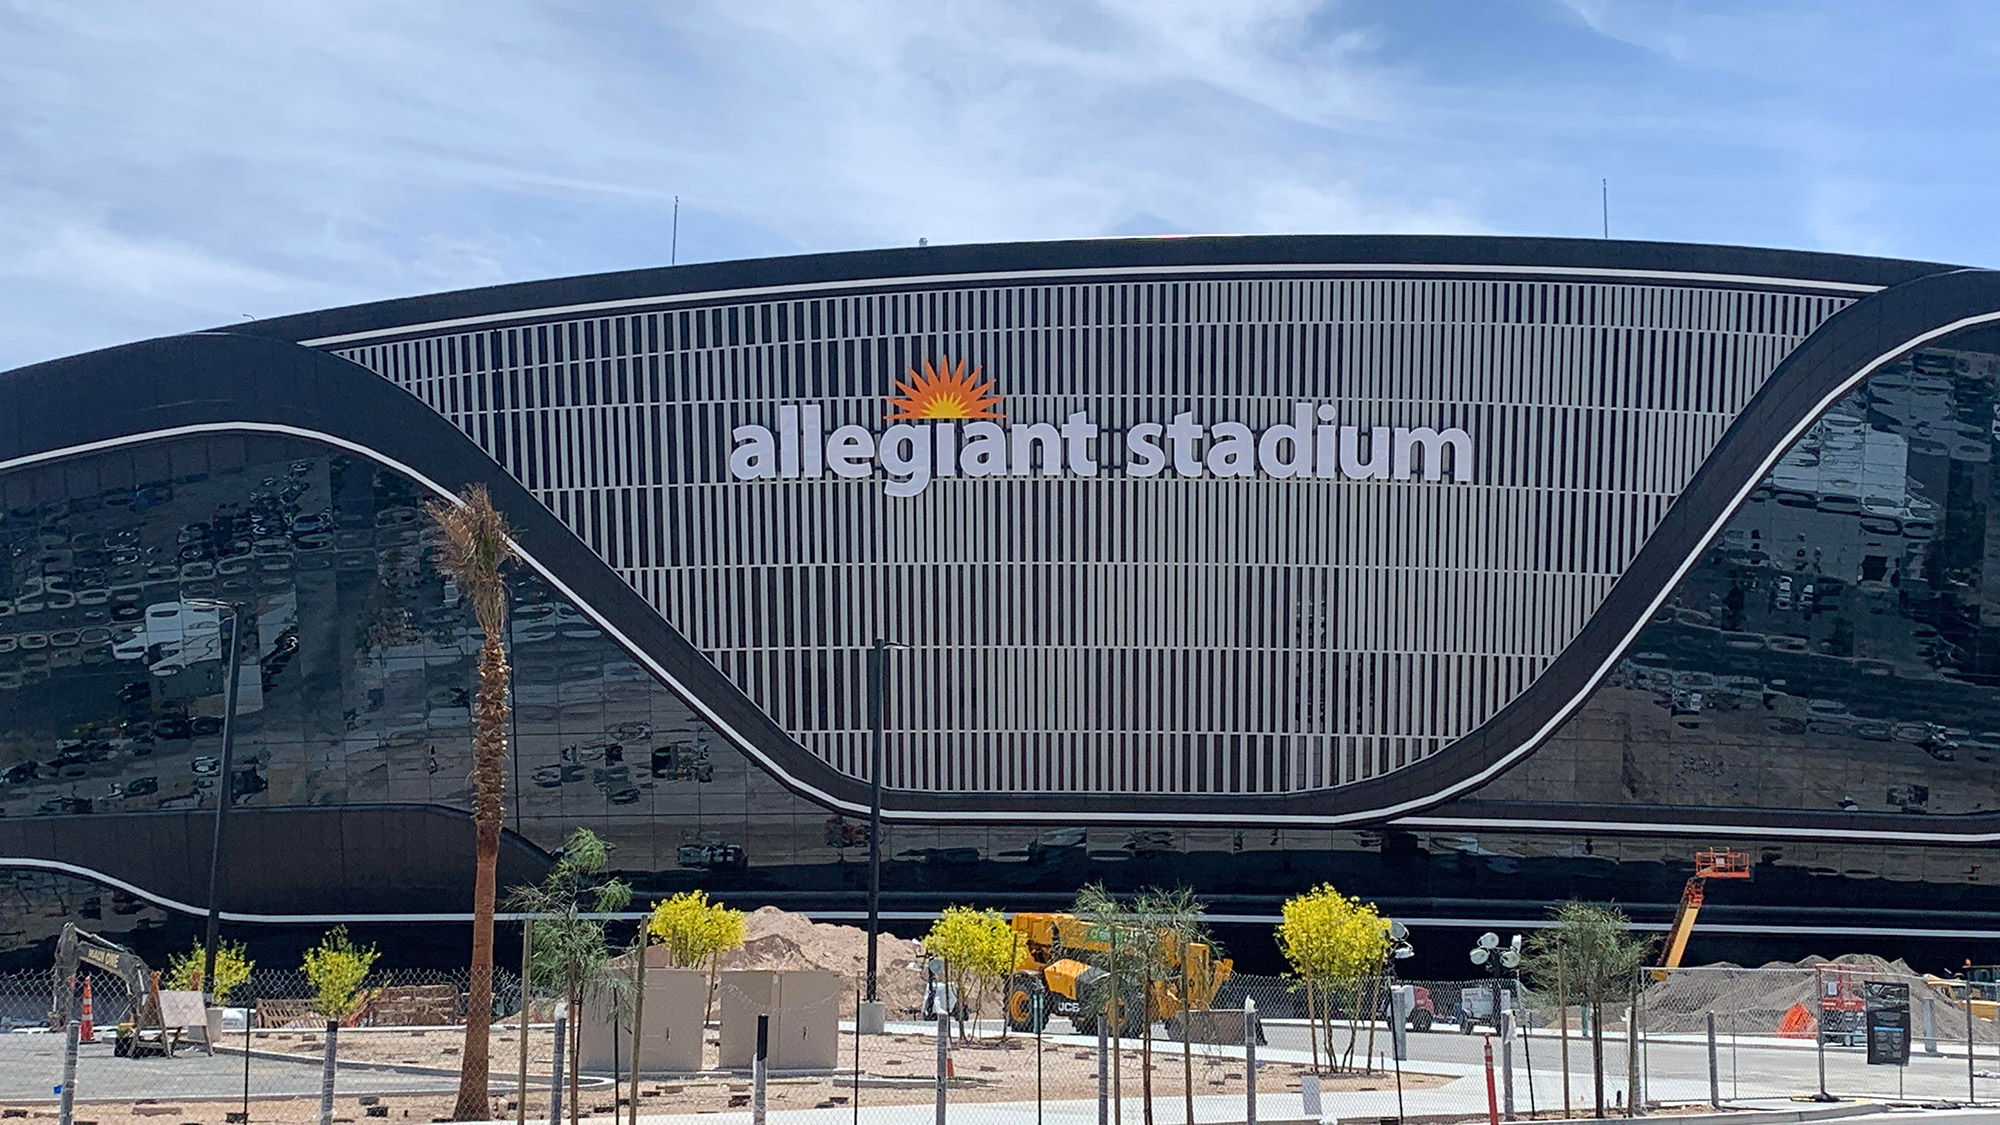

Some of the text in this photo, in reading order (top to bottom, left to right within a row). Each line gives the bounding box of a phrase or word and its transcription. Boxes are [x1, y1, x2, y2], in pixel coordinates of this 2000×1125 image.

[730, 402, 1471, 498] allegiant stadium
[1058, 1002, 1080, 1012] JCB
